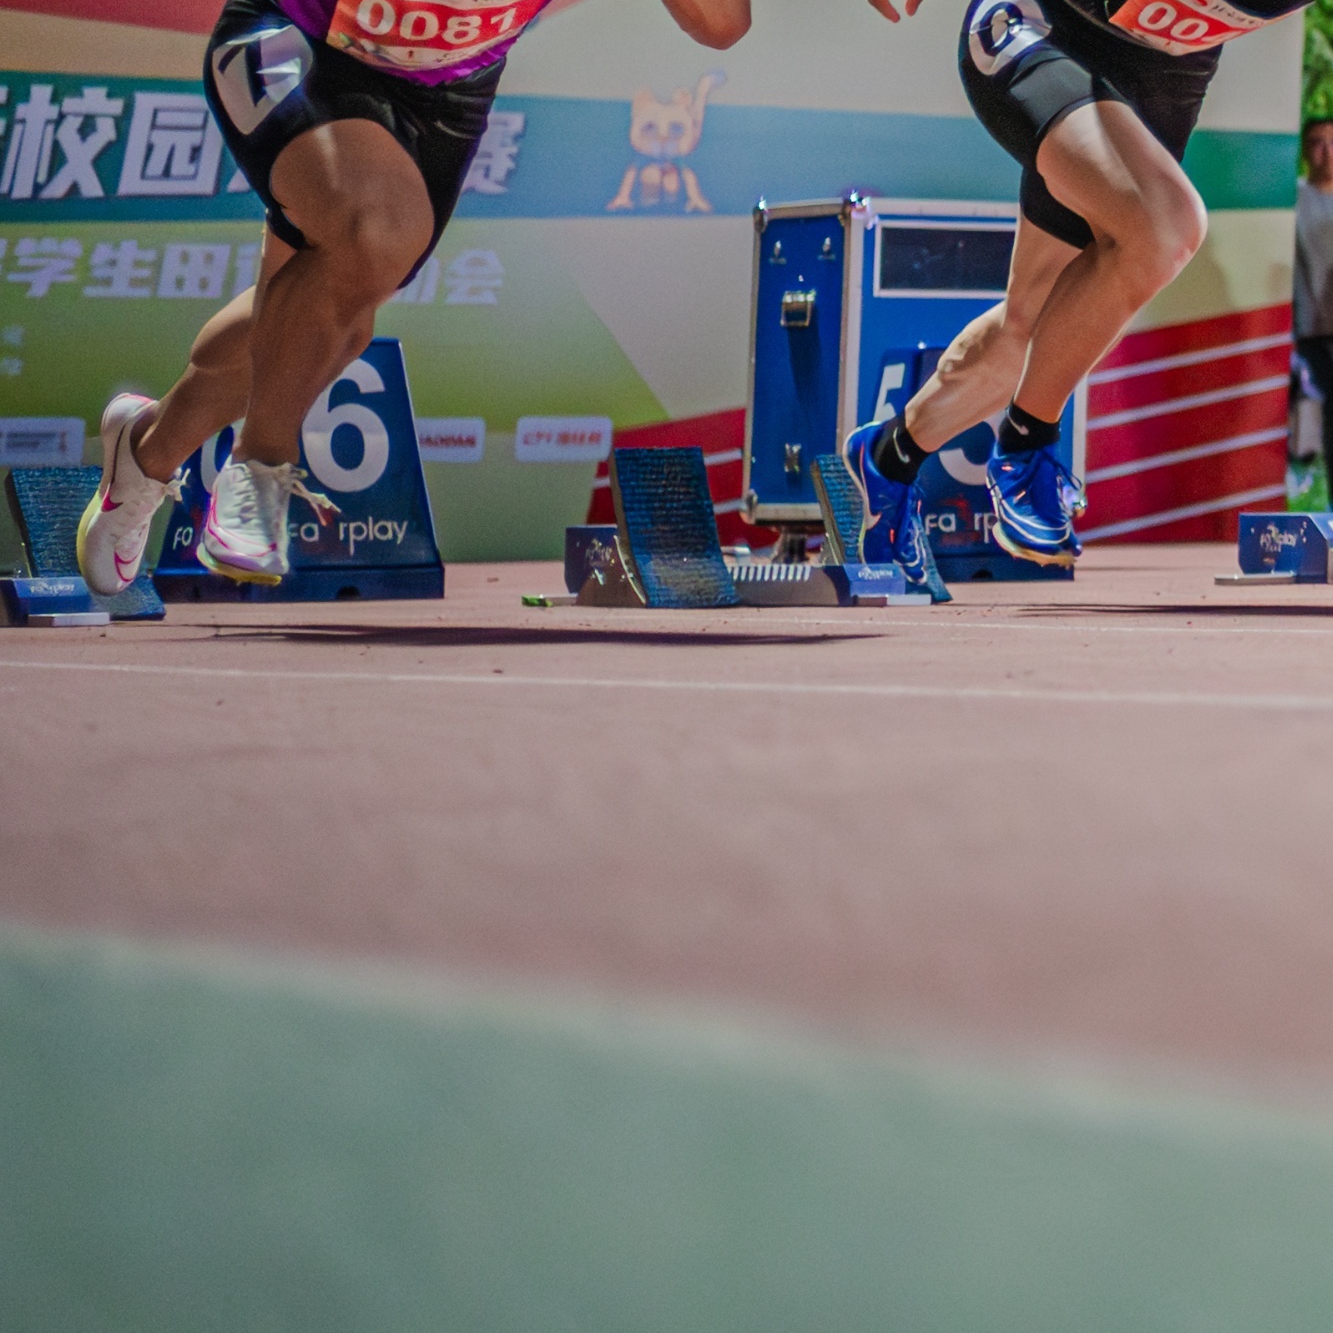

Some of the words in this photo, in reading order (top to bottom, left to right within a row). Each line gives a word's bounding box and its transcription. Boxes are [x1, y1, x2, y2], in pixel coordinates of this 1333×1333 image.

[0, 84, 250, 199] 校园
[0, 237, 258, 300] 学生田
[301, 358, 389, 493] 6
